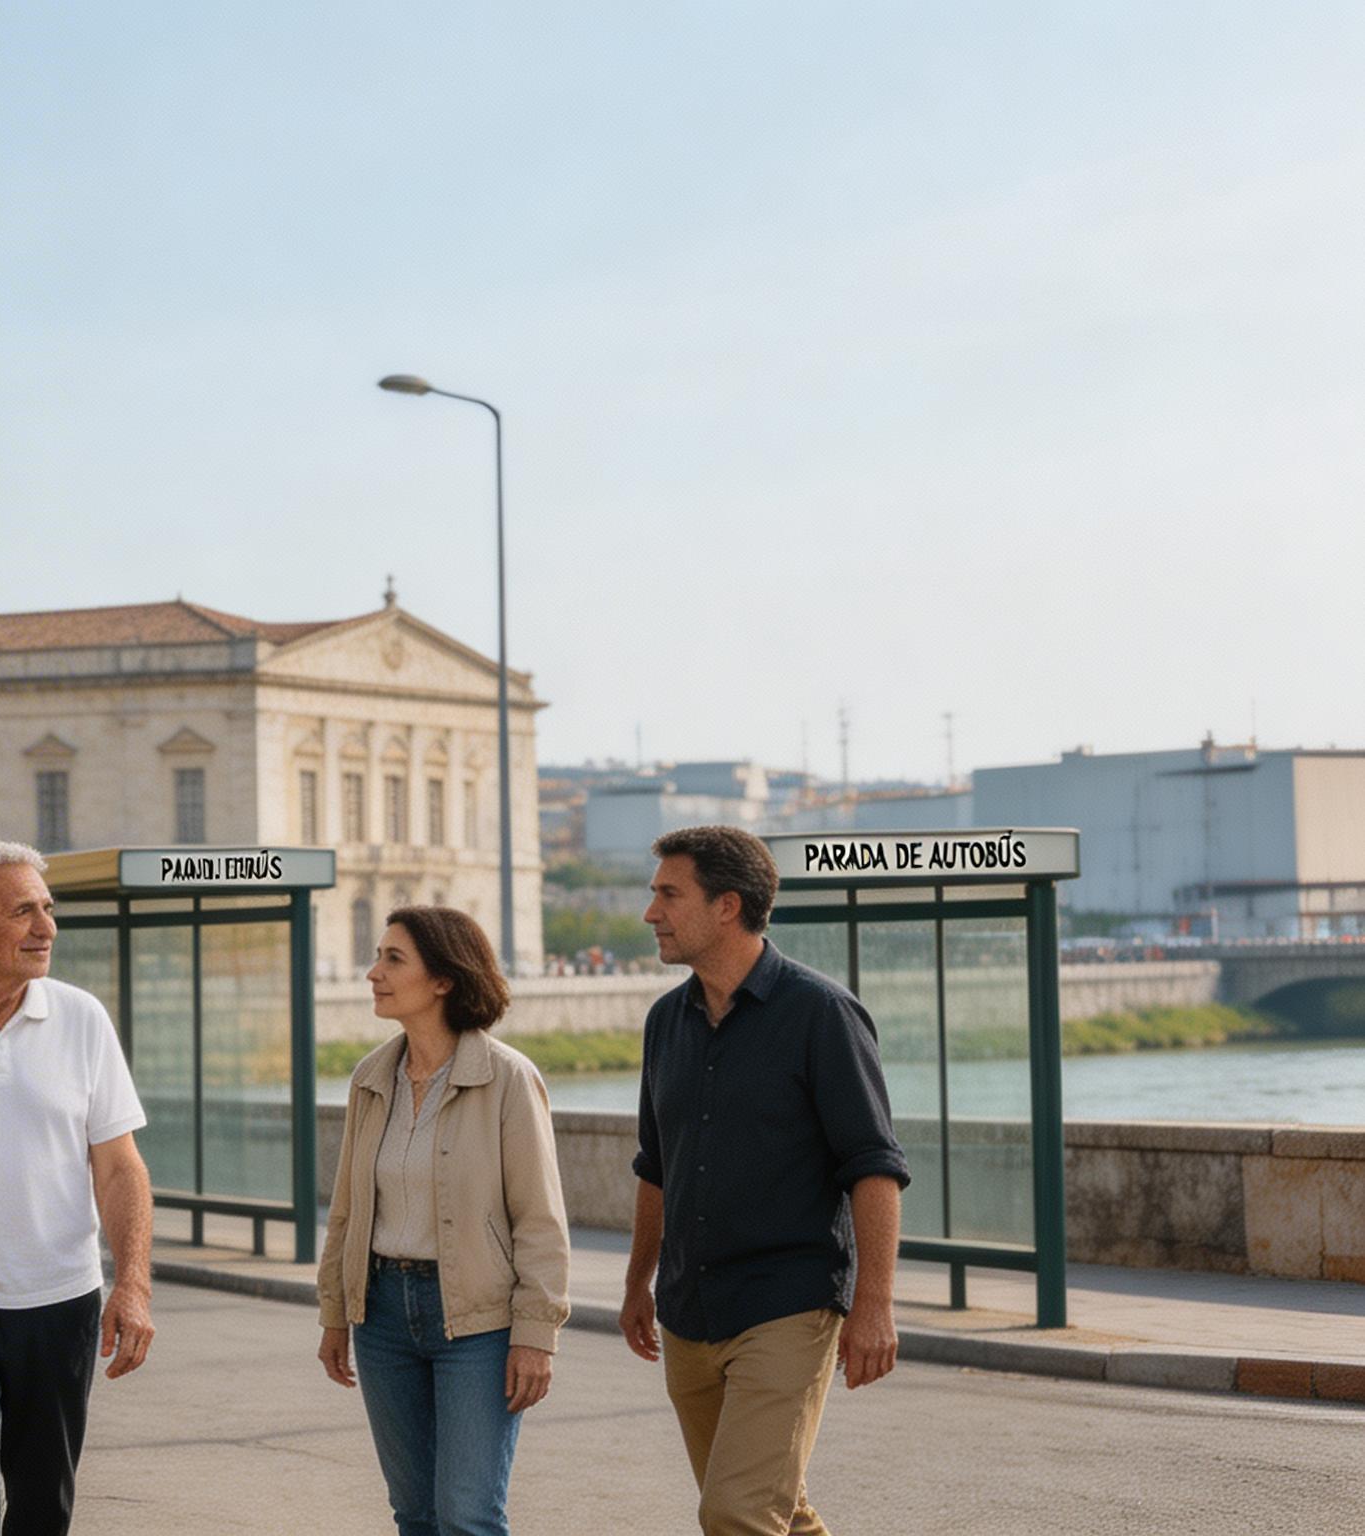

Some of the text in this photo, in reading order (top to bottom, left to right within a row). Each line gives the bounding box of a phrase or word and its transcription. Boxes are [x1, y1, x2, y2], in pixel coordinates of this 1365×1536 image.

[805, 830, 1026, 871] PARADA DE AUTOBÚS
